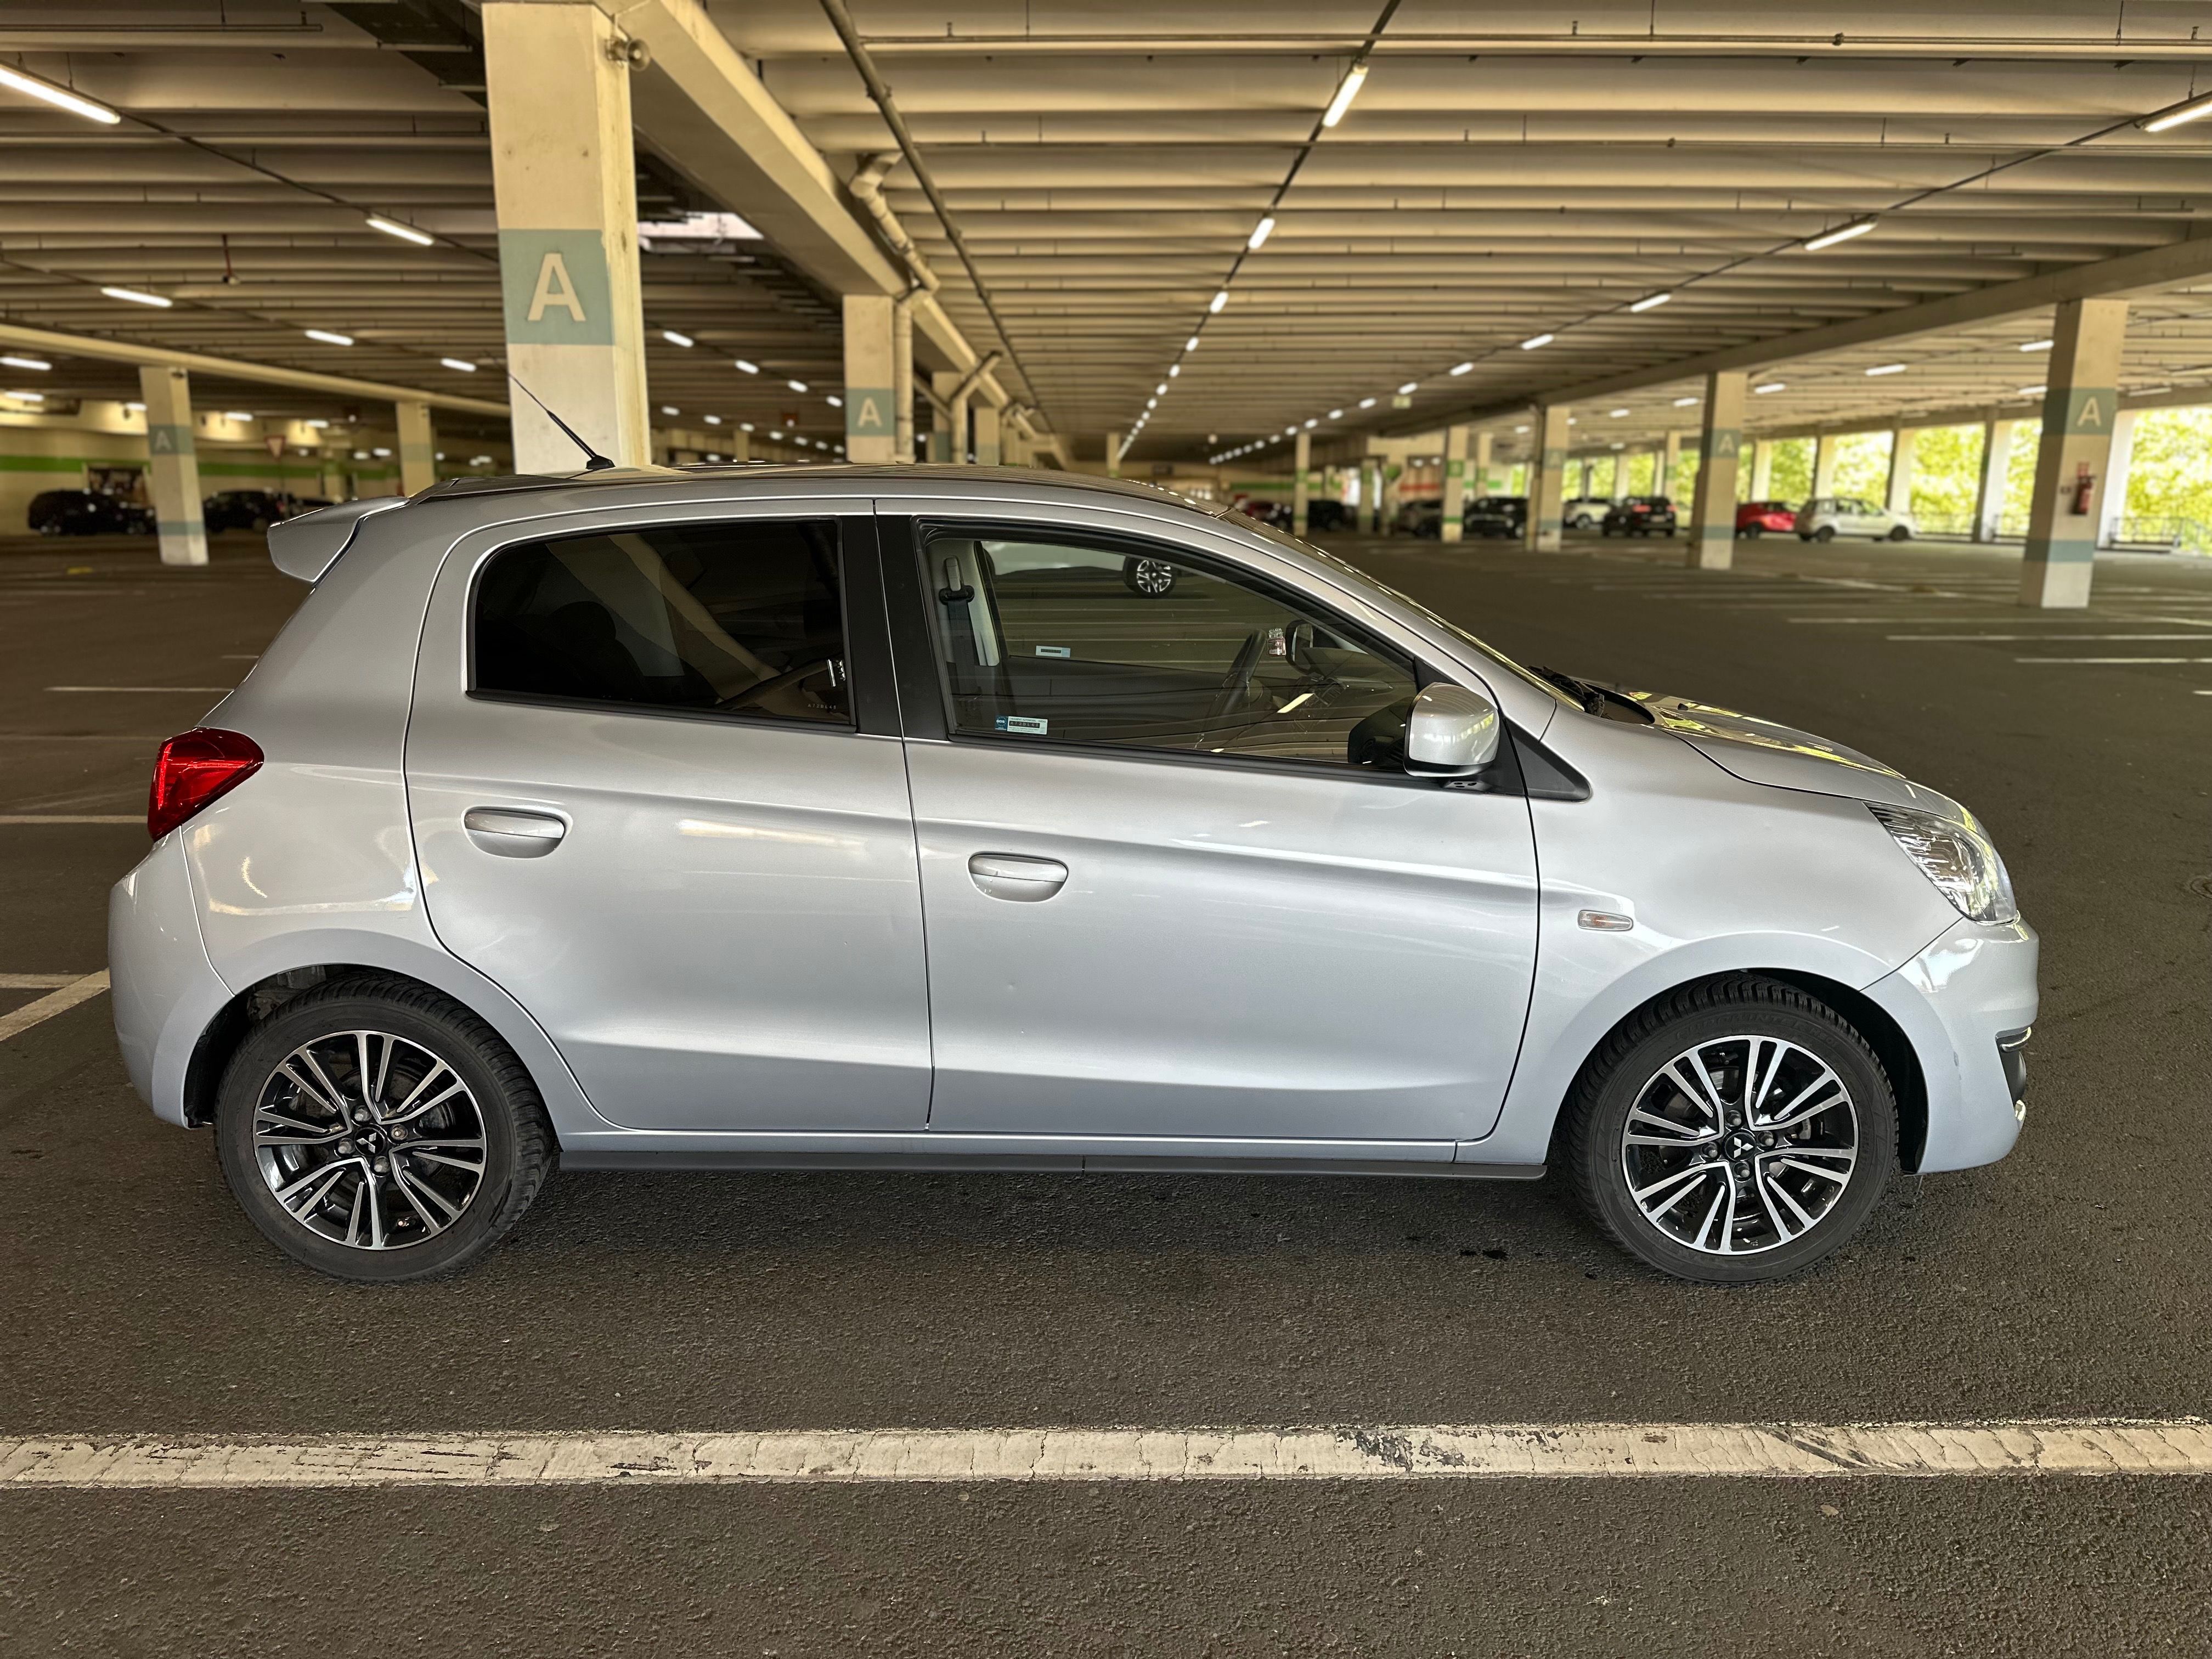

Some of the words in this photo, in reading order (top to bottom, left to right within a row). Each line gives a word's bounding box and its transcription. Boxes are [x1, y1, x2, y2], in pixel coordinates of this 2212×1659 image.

[527, 253, 586, 321] A
[858, 397, 882, 427] A
[2077, 396, 2101, 426] A
[155, 430, 171, 450] A
[1719, 433, 1734, 453] A
